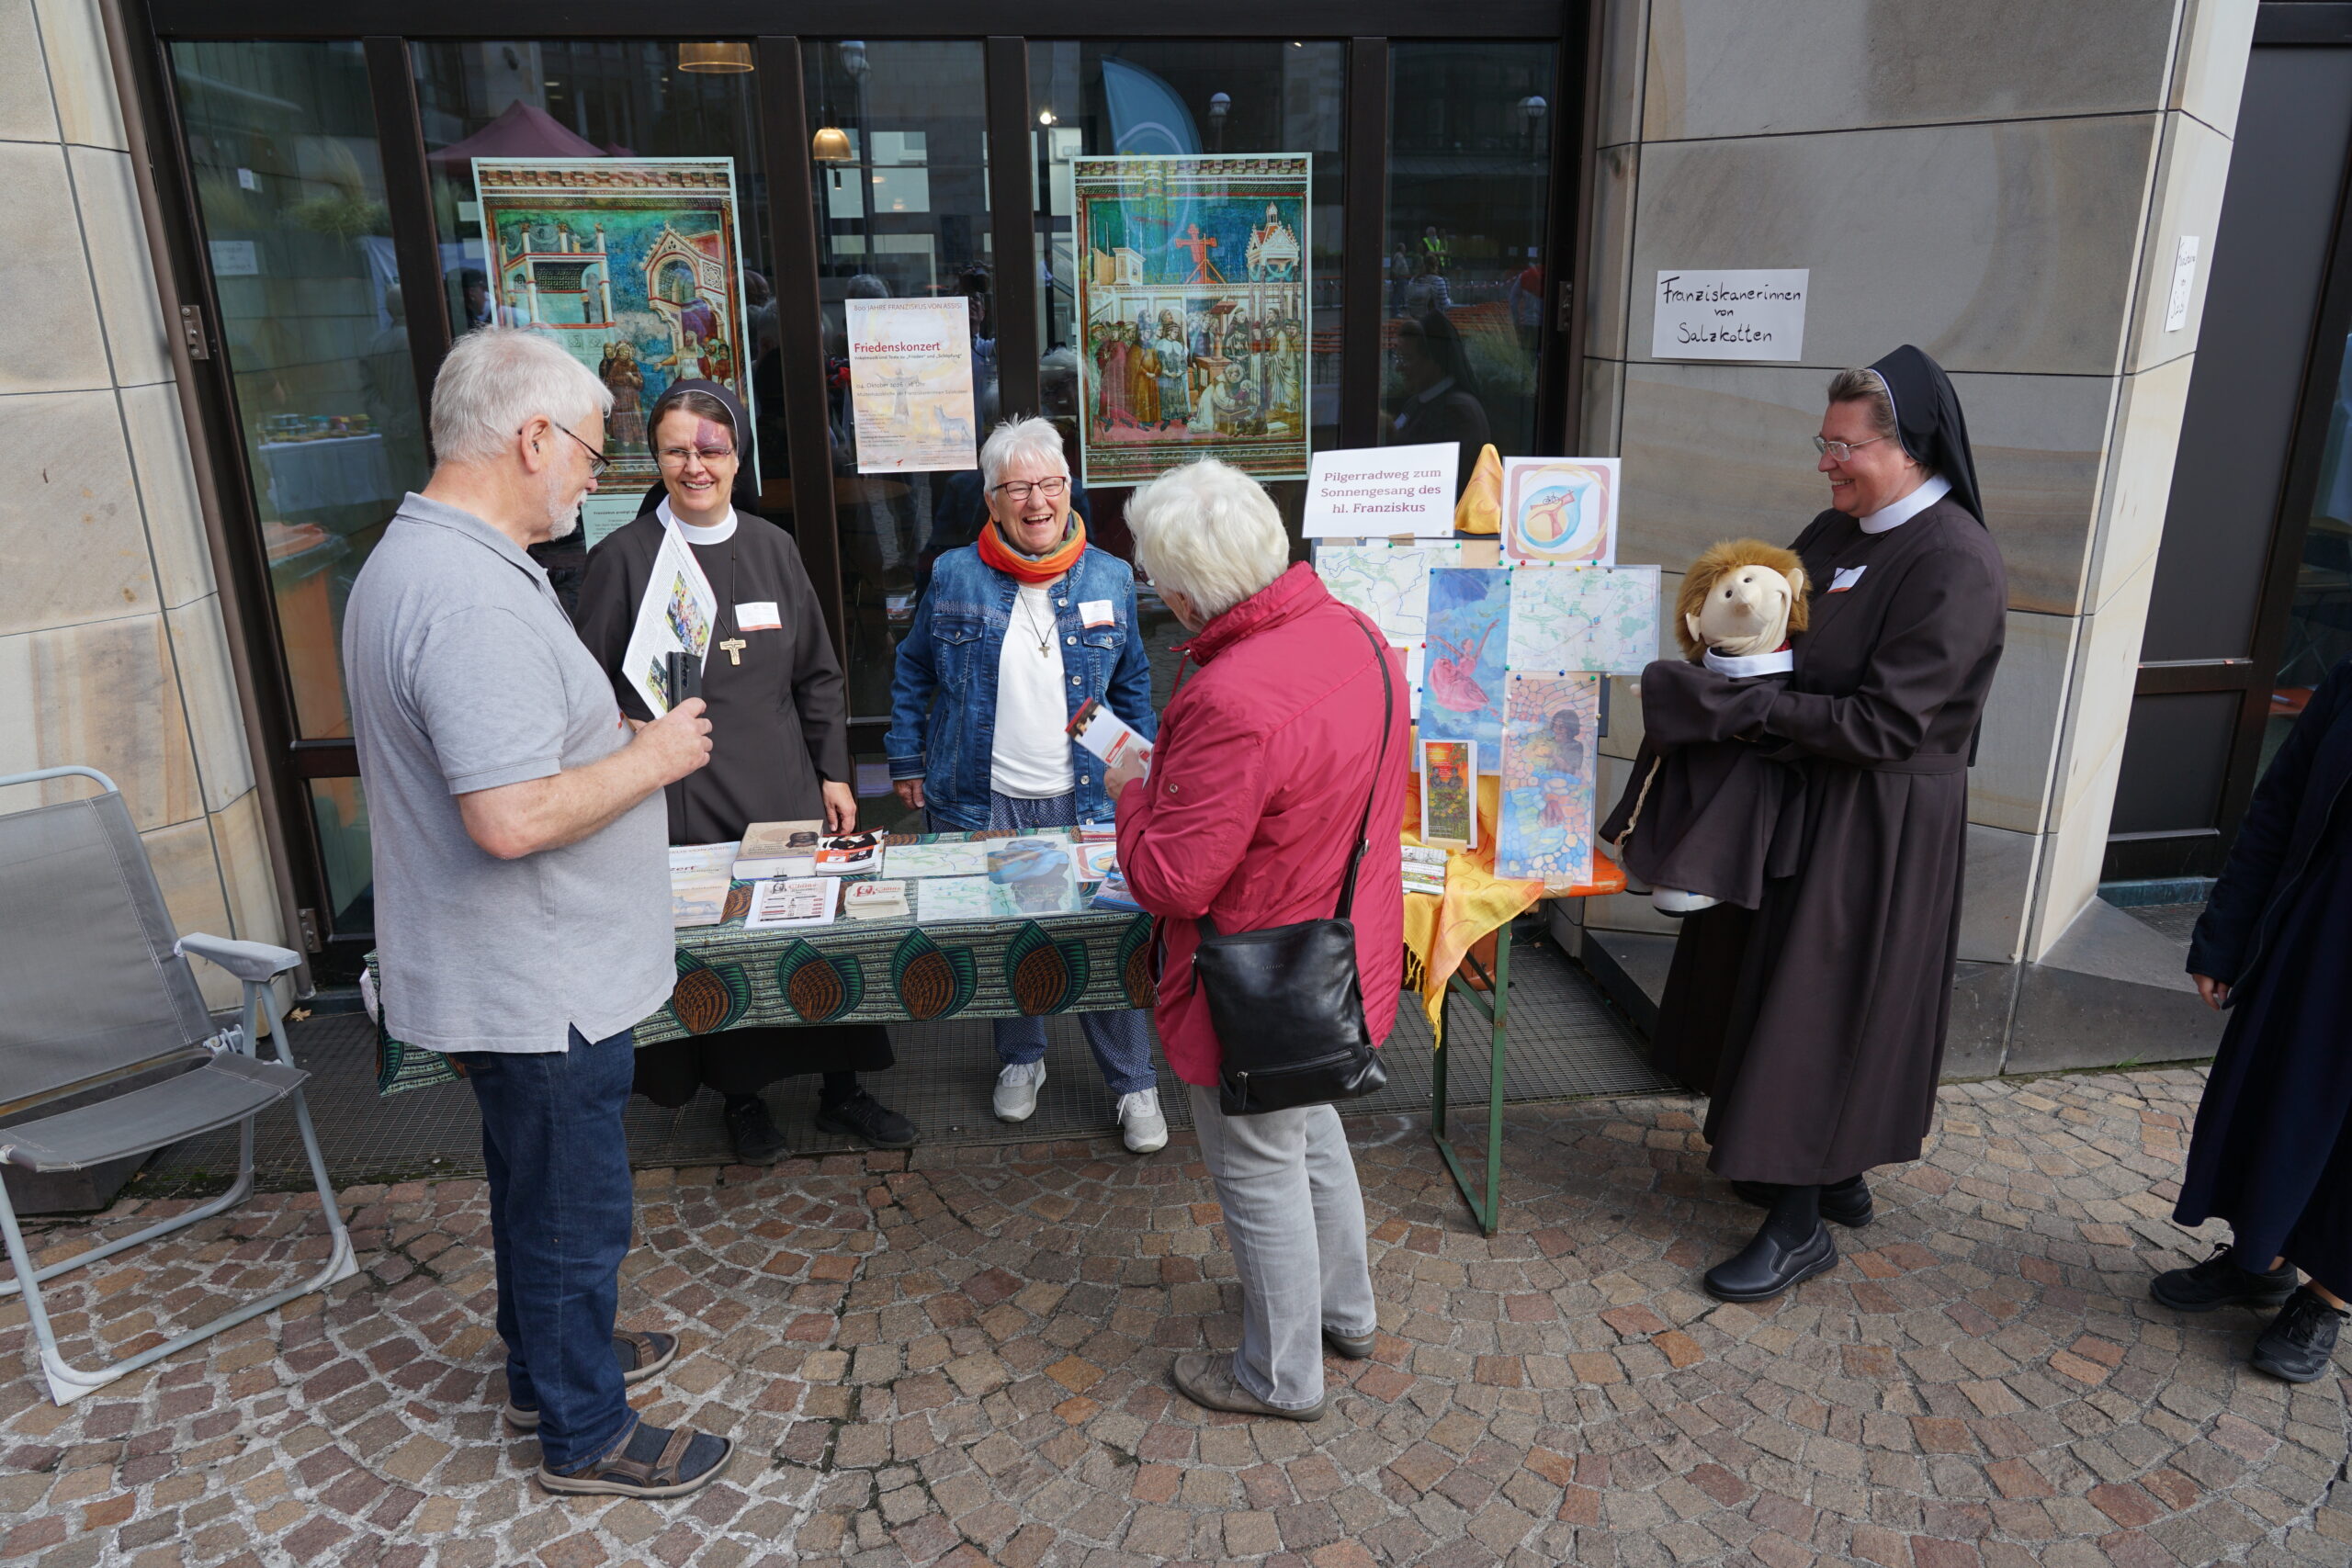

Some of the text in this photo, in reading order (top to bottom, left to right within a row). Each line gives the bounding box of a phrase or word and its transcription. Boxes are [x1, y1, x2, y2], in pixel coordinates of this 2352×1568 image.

[1660, 276, 1801, 304] Franziskanerinnen
[868, 304, 887, 312] JAHRE
[1714, 308, 1734, 317] von
[1677, 322, 1772, 344] Salzkotten
[854, 341, 941, 353] Friedenskonzert
[1323, 468, 1442, 483] Pilgerradweg zum
[1321, 485, 1441, 498] Sonnengesang des
[1332, 502, 1426, 513] hl. Franziskus
